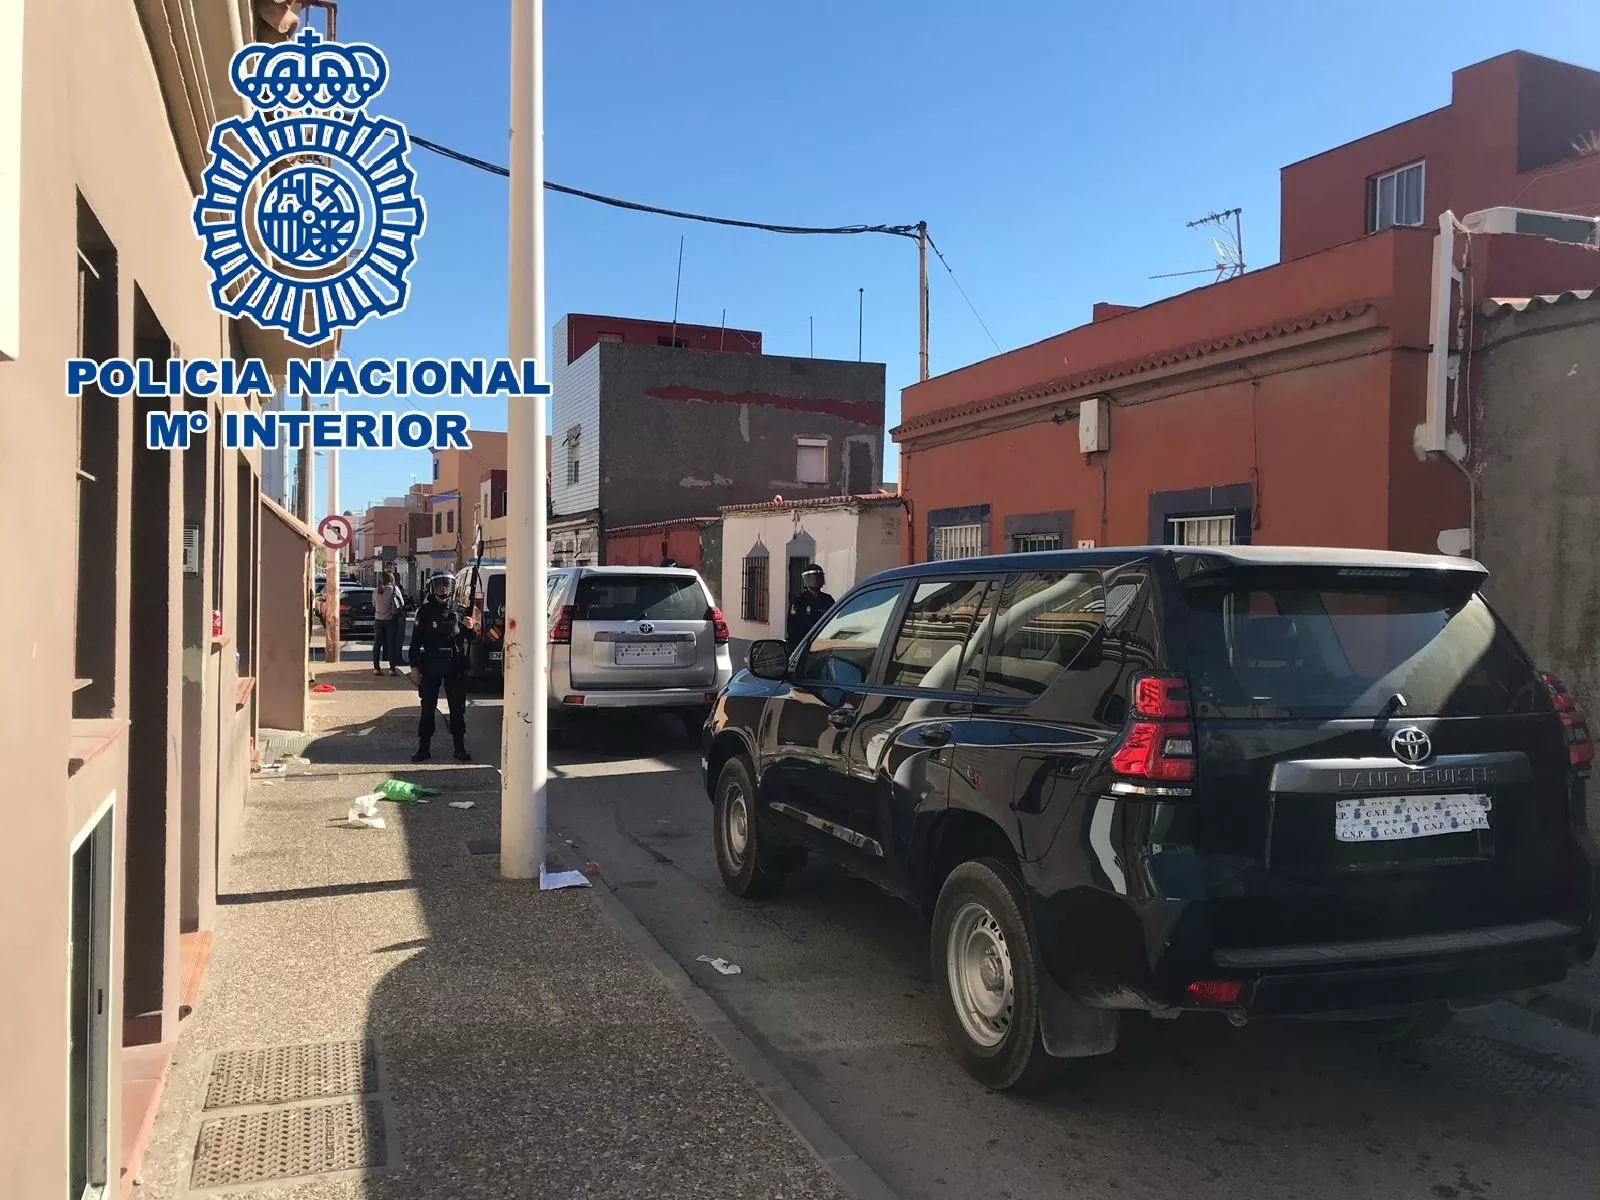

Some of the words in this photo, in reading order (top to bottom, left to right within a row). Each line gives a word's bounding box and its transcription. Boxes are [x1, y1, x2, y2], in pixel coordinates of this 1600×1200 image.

[1338, 771, 1398, 788] LAND
[1407, 766, 1494, 785] CRUISER
[1341, 830, 1366, 839] C.N.P.
[1383, 826, 1407, 836] C.N.P.
[1423, 822, 1446, 831] C.N.P.
